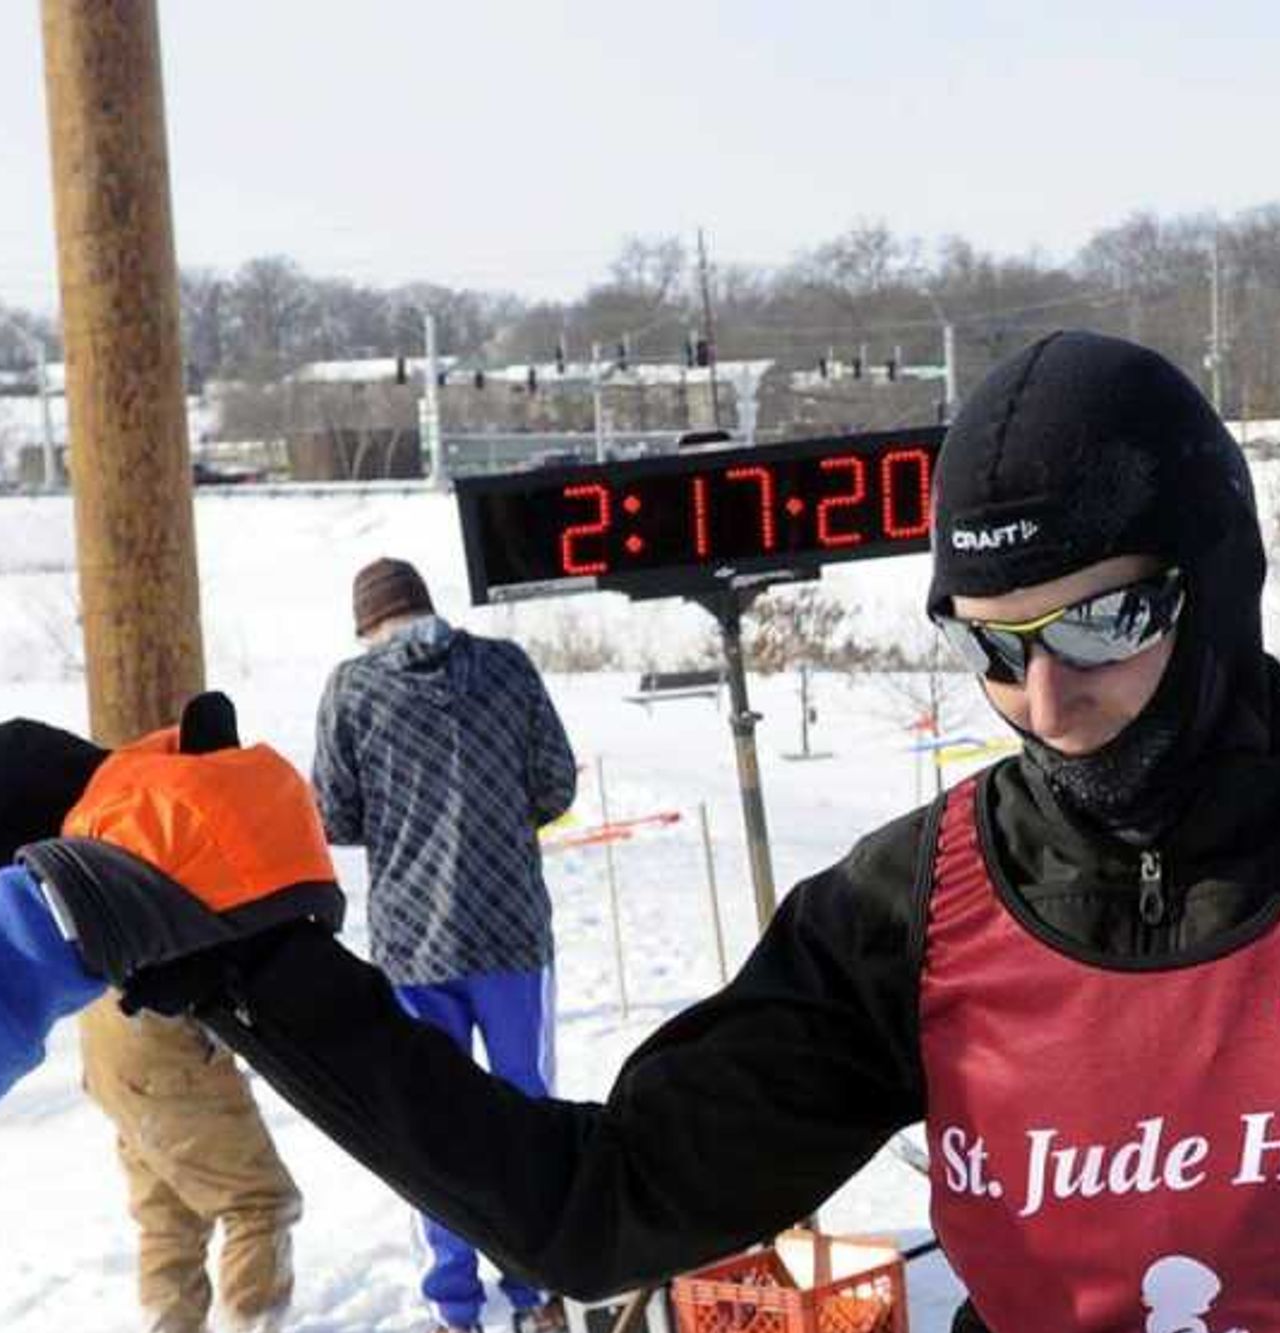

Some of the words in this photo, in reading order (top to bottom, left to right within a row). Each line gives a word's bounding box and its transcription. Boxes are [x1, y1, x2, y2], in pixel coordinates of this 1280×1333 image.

[951, 522, 1019, 550] CRAFT
[941, 1126, 1005, 1199] St.
[1018, 1116, 1210, 1218] Jude
